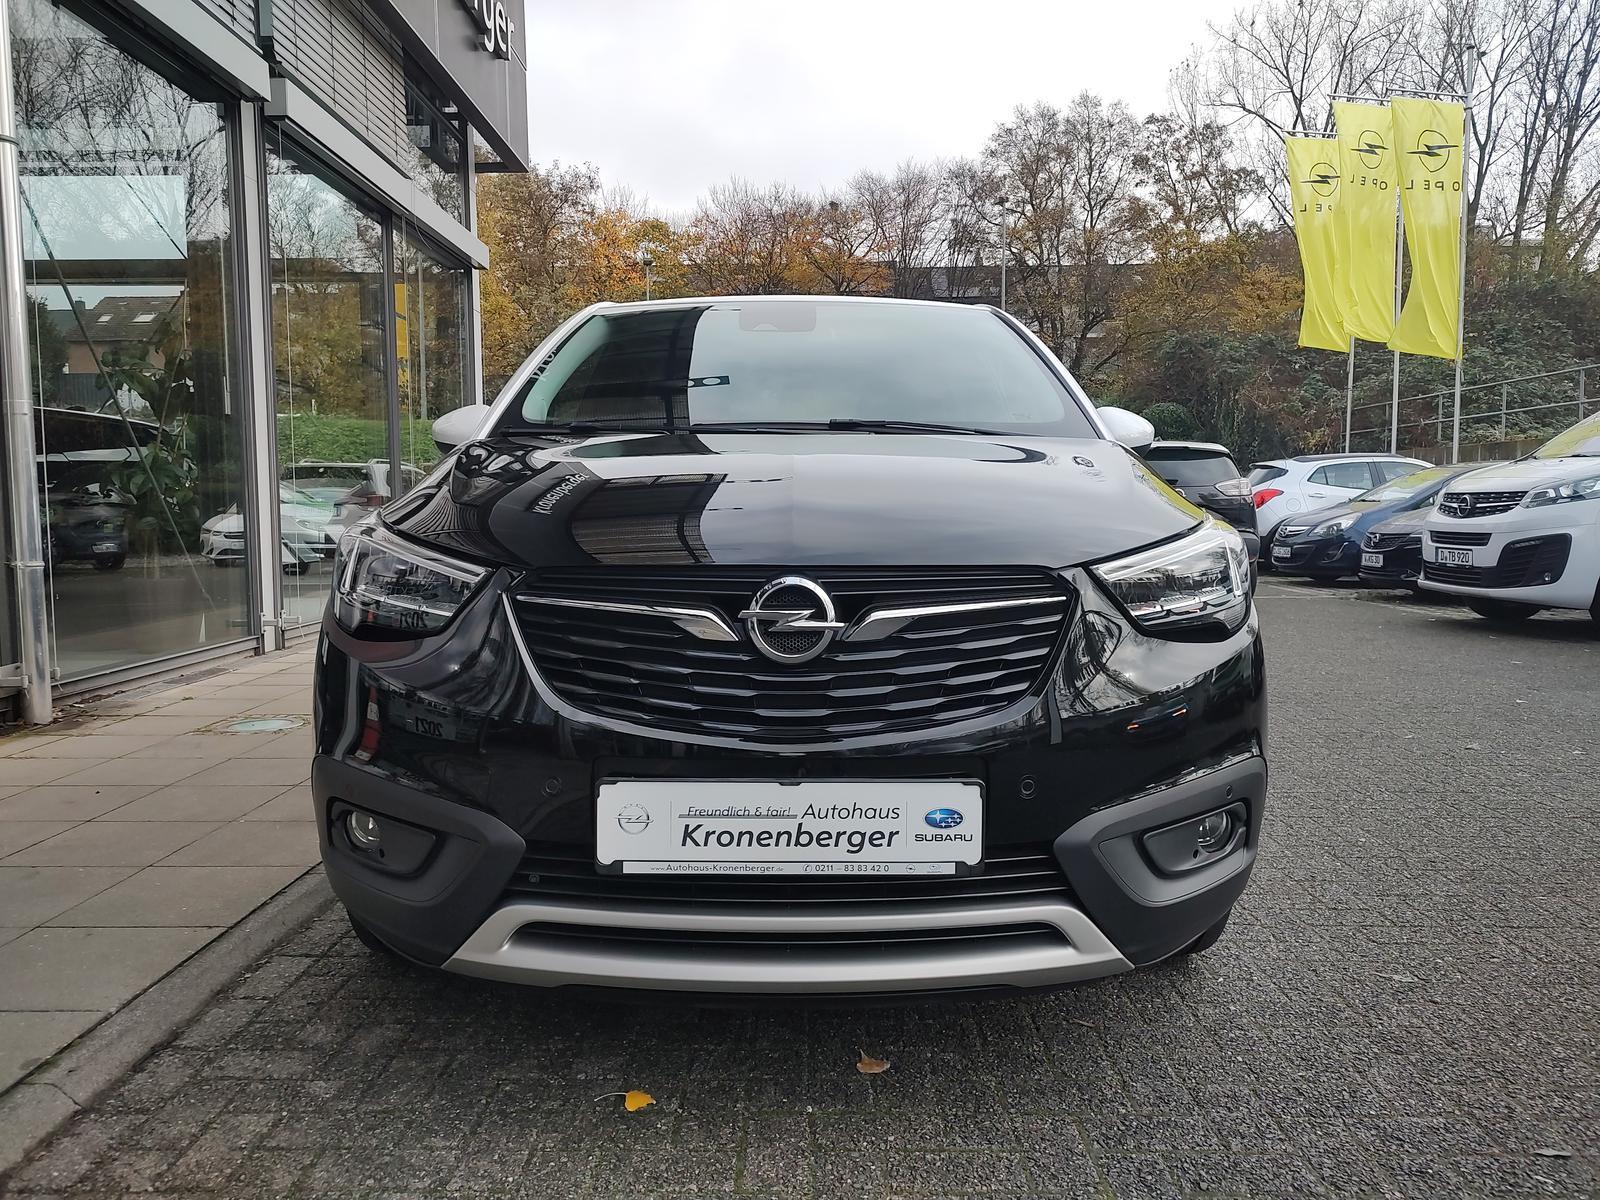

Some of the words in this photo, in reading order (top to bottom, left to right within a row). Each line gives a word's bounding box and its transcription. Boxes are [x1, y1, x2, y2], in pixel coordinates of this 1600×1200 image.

[475, 0, 514, 60] ger
[687, 806, 751, 817] Freundlich
[754, 807, 762, 817] &
[765, 806, 791, 817] fair!
[801, 802, 900, 820] Autohaus
[681, 822, 900, 854] Kronenberger
[914, 833, 973, 842] SUBARU
[650, 863, 784, 873] www.Autohaus-Kronenberger.de
[815, 864, 834, 872] 0211
[844, 864, 855, 872] 83
[857, 864, 868, 872] 83
[870, 864, 881, 872] 42
[883, 864, 889, 872] 0
